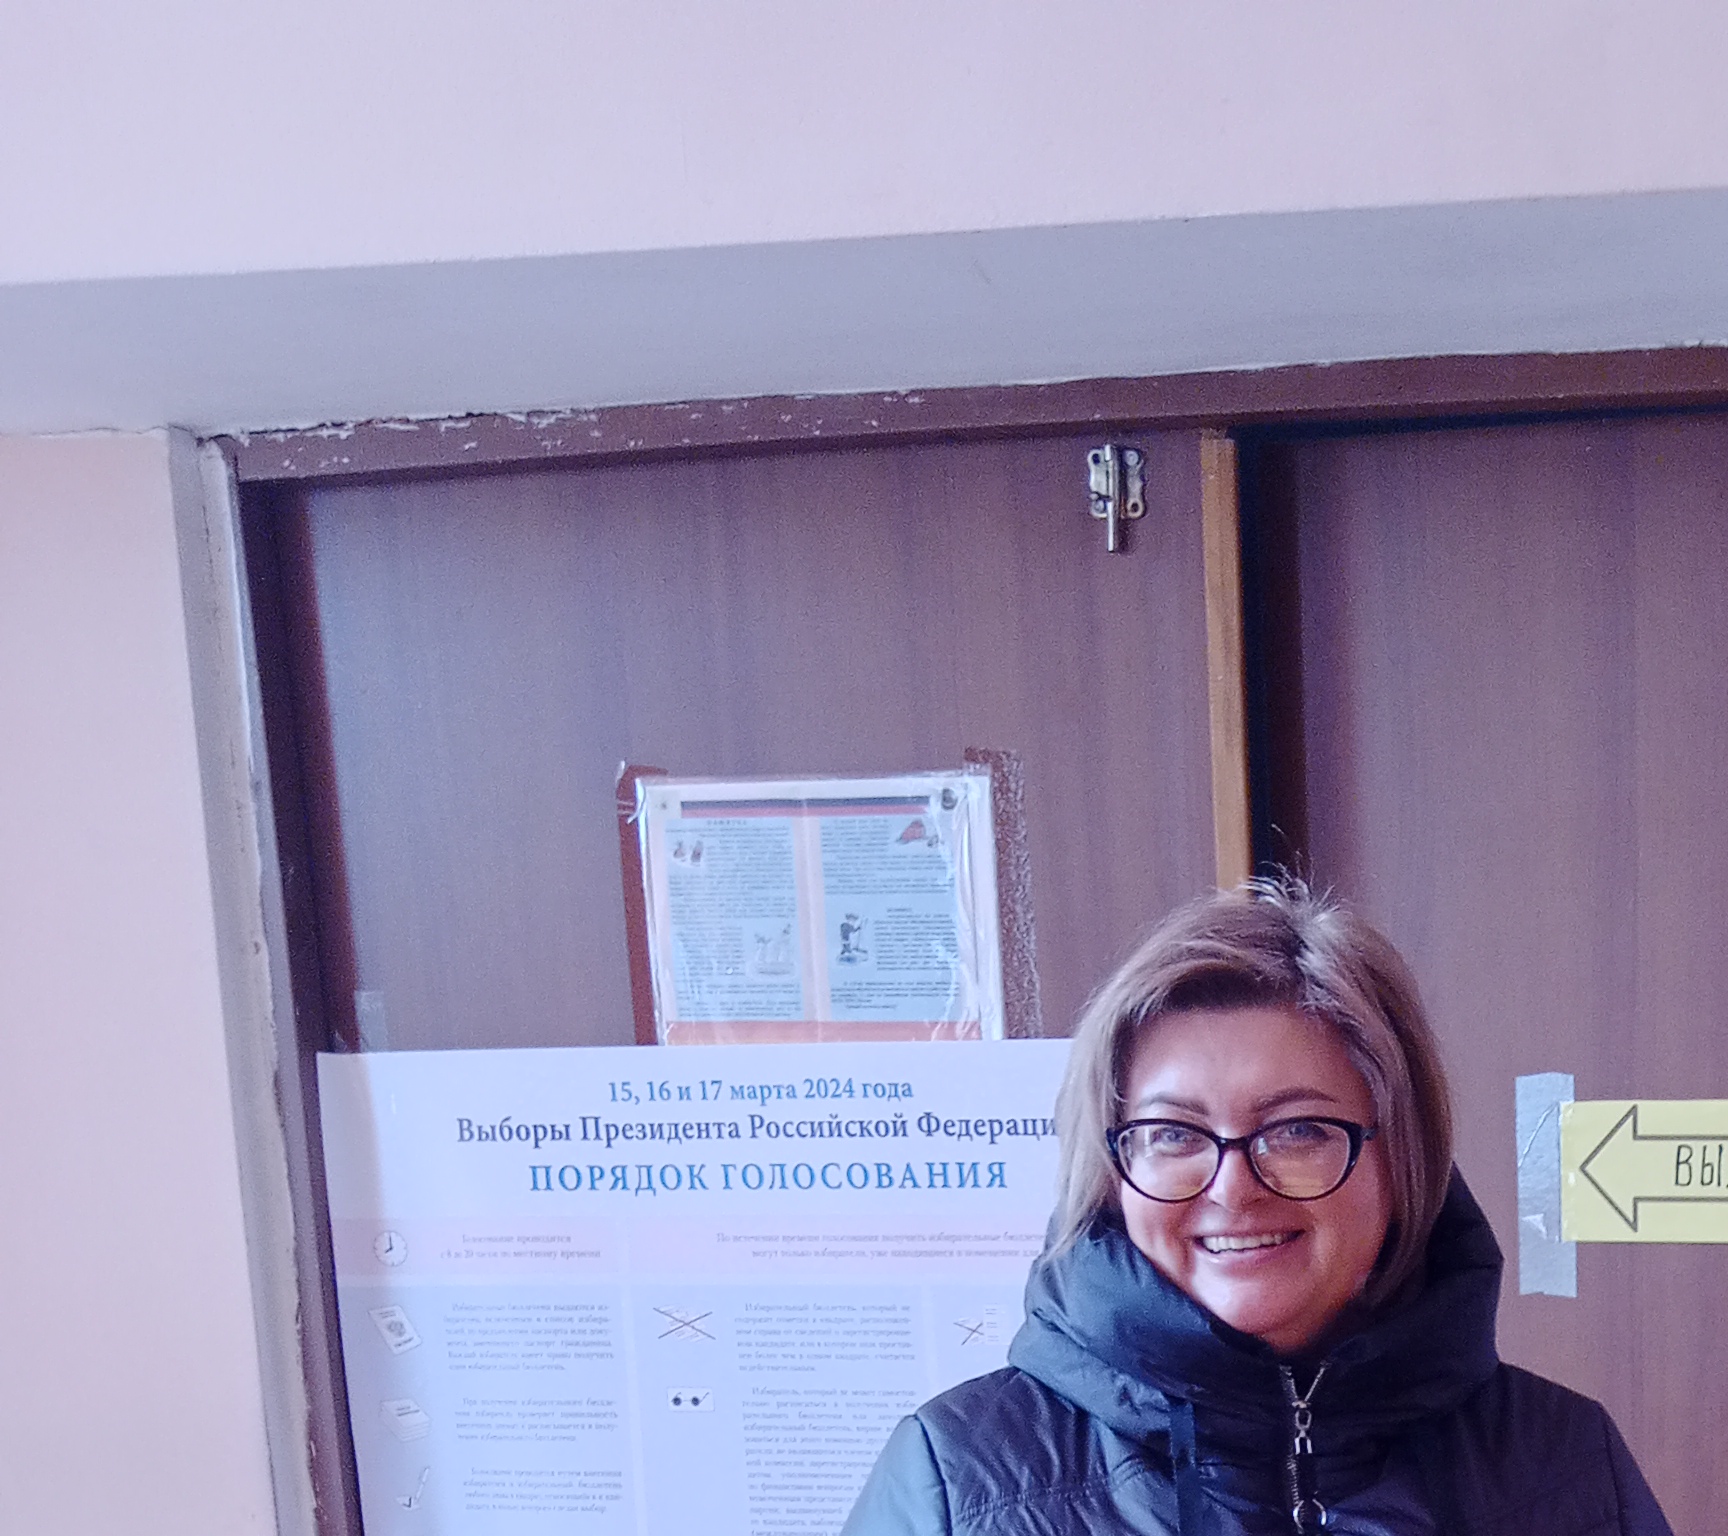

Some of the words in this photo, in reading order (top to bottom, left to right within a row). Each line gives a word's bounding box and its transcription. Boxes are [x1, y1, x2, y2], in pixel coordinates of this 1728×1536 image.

[608, 1081, 641, 1105] 15,
[647, 1081, 671, 1102] 16
[677, 1085, 692, 1101] и
[699, 1080, 723, 1101] 17
[729, 1081, 798, 1106] марта
[803, 1078, 855, 1099] 2024
[861, 1081, 914, 1102] года
[457, 1116, 572, 1150] Выборы
[579, 1115, 742, 1149] Президента
[748, 1113, 910, 1140] Российской
[917, 1111, 1060, 1145] Федераци
[528, 1163, 709, 1197] ПОРЯДОК
[721, 1160, 1008, 1191] ГОЛОСОВАНИЯ
